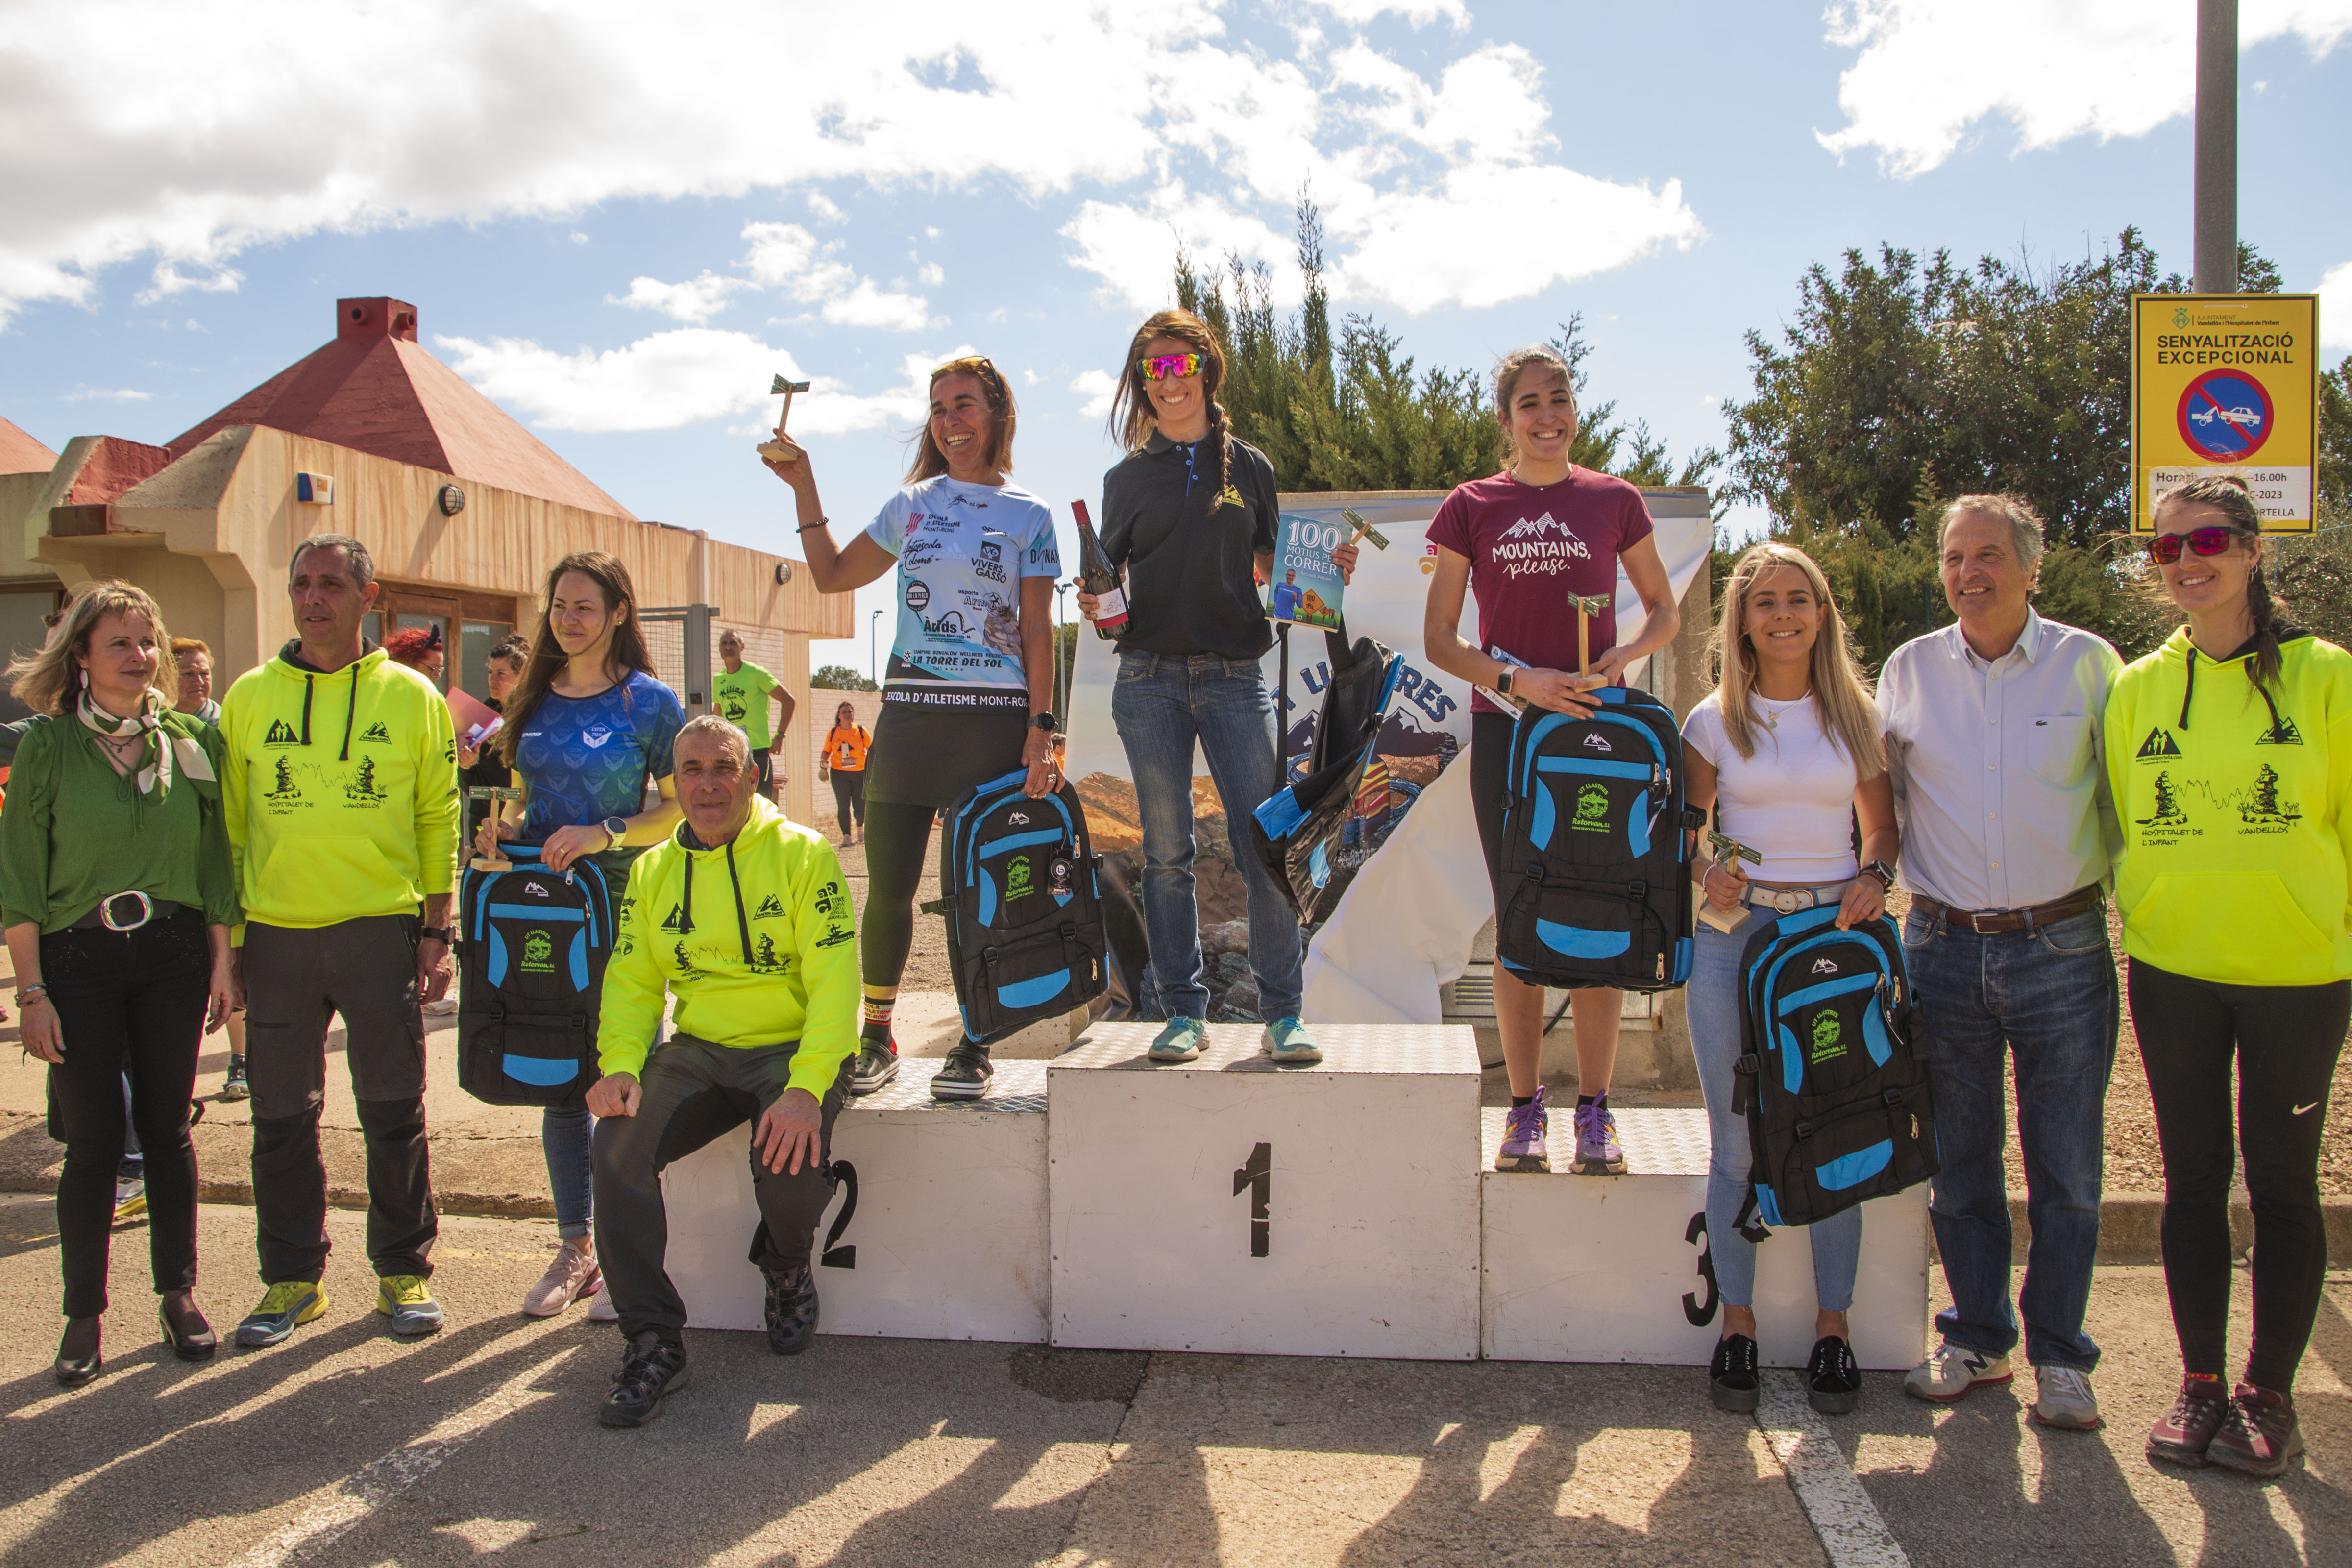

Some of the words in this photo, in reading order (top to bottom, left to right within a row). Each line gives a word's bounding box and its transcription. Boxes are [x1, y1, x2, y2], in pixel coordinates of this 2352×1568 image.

[2157, 331, 2294, 348] SENYALITZACIÓ
[2157, 351, 2294, 364] EXCEPCIONAL
[2253, 508, 2295, 517] ORTELLA
[1287, 519, 1342, 553] 100
[1286, 545, 1320, 559] MOTIUS
[1322, 552, 1335, 564] PE
[1492, 541, 1591, 563] MOUNTAINS,
[971, 557, 1004, 574] VIVERS
[1284, 552, 1337, 577] CÓRRER
[1502, 558, 1571, 580] please.
[975, 567, 1007, 584] GASSÓ
[913, 655, 922, 664] LA
[926, 656, 958, 666] TORRE
[961, 658, 980, 667] DEL
[983, 659, 1003, 668] SOL
[885, 691, 910, 702] ESCOLA
[980, 695, 1028, 708] MONT-ROIG
[1585, 783, 1609, 795] LLASTRES
[2237, 826, 2289, 835] VANDELLÒS
[1011, 855, 1030, 864] LLASTRES
[530, 929, 551, 940] LLASTRES
[1816, 1009, 1839, 1019] LLASTRES
[1233, 1142, 1272, 1258] 1
[821, 1160, 858, 1269] 2
[1682, 1211, 1720, 1328] 3
